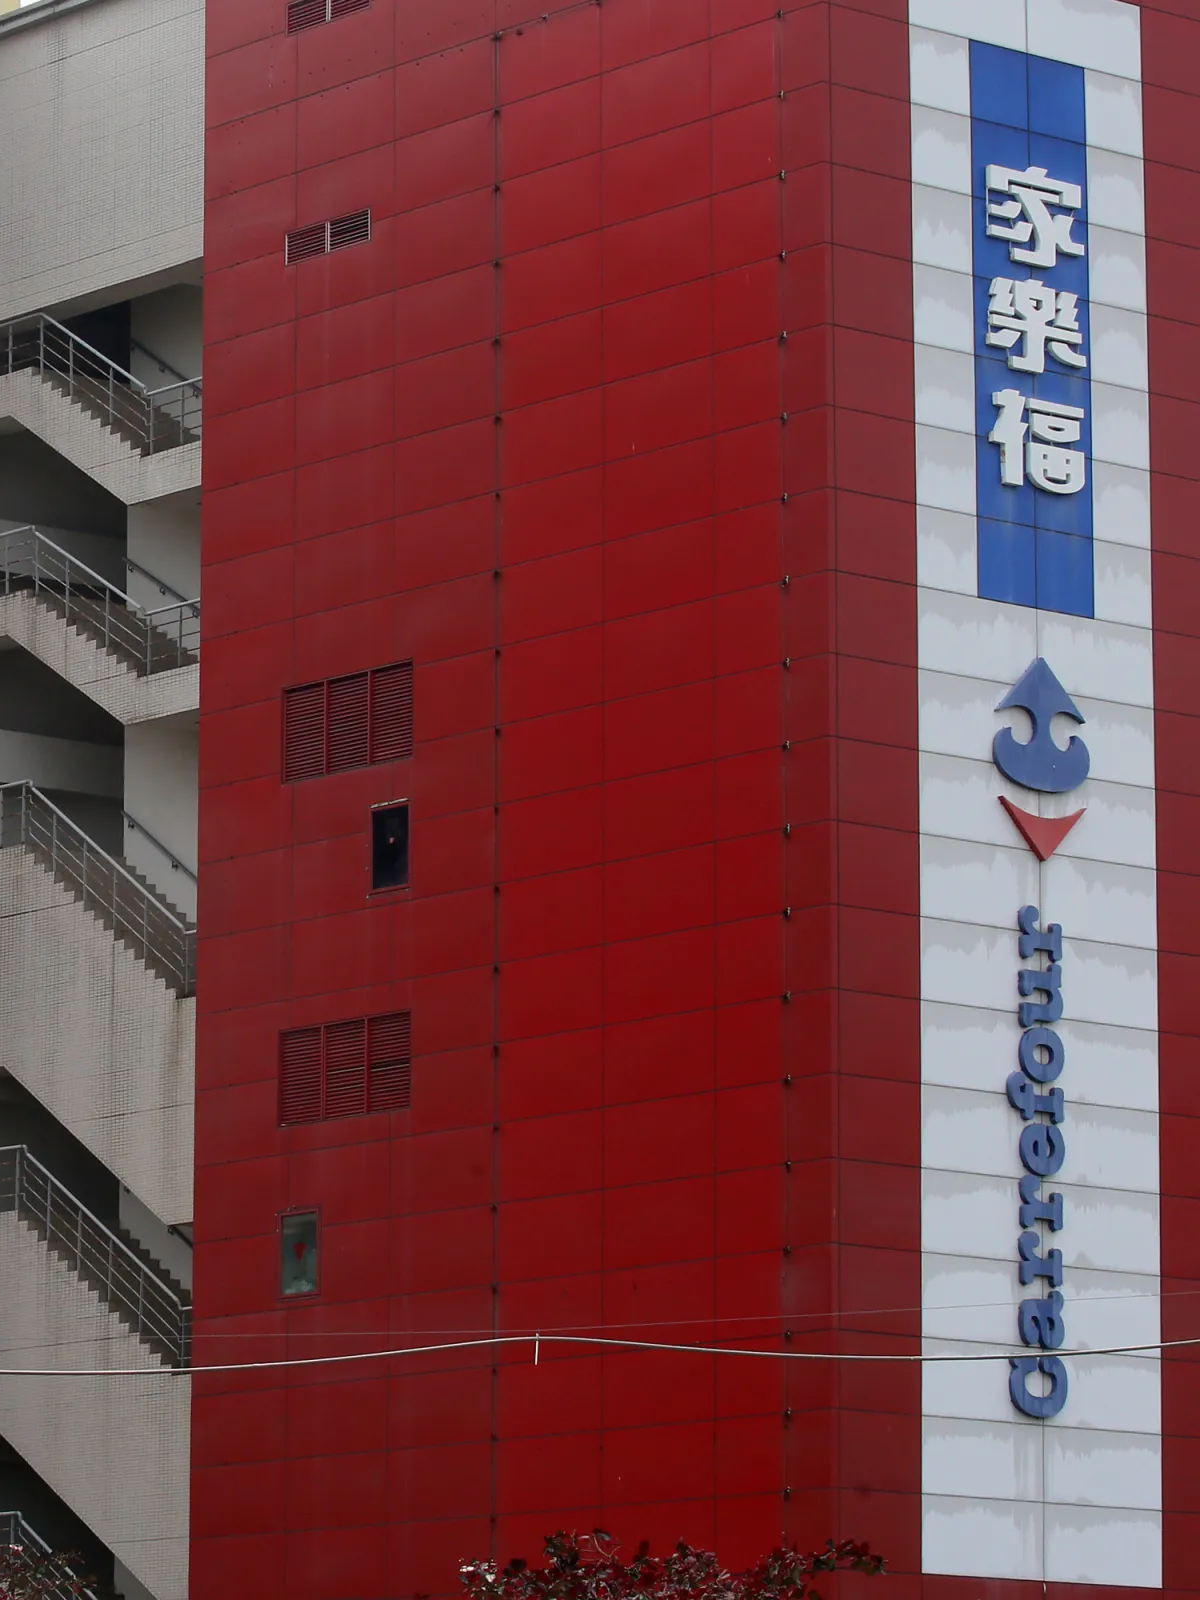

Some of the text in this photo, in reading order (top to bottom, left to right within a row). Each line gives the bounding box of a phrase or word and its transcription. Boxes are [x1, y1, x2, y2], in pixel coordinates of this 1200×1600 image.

[985, 163, 1087, 495] 家樂福
[1007, 904, 1067, 1418] Carrefour
